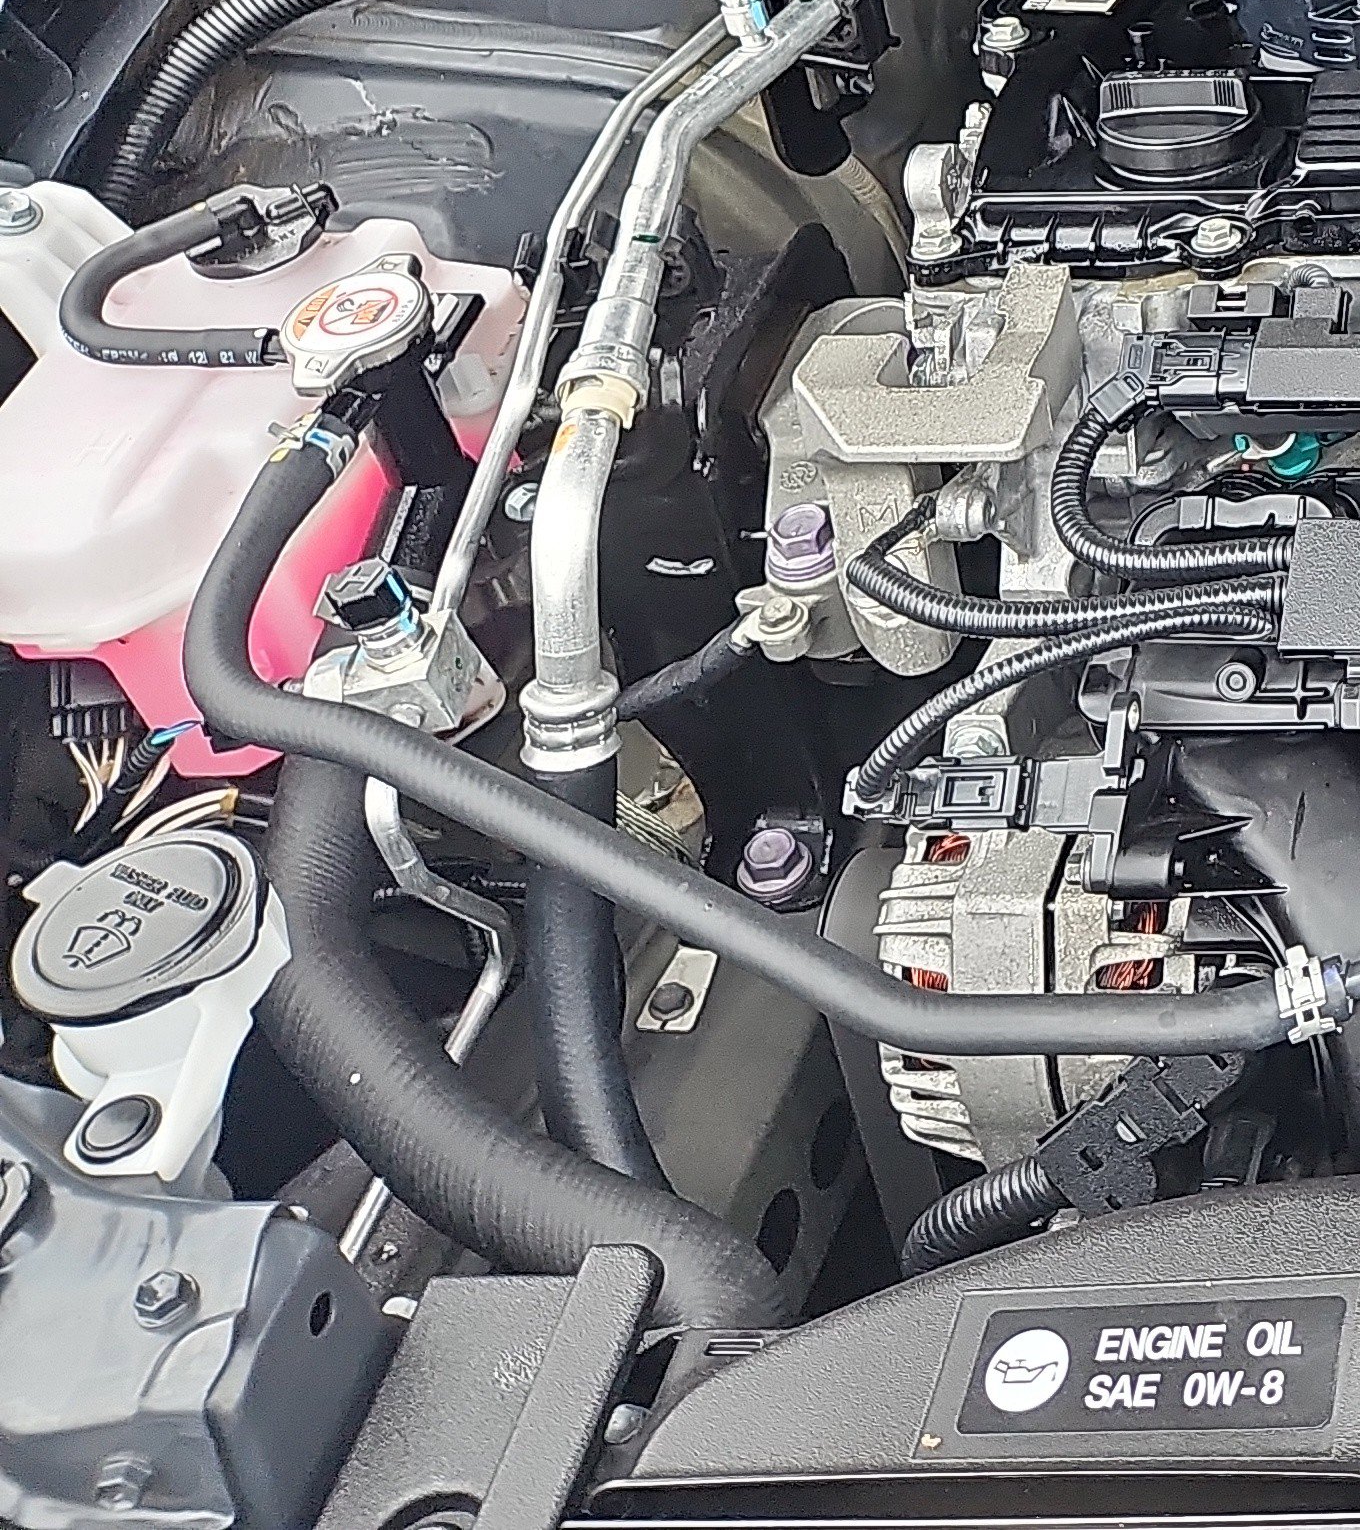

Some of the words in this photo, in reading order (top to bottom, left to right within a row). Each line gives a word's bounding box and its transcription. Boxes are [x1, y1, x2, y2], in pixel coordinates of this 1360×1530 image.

[1095, 1323, 1227, 1362] ENGINE
[1246, 1320, 1302, 1357] OIL
[1083, 1373, 1161, 1410] SAE
[1183, 1370, 1285, 1407] 0W-8
